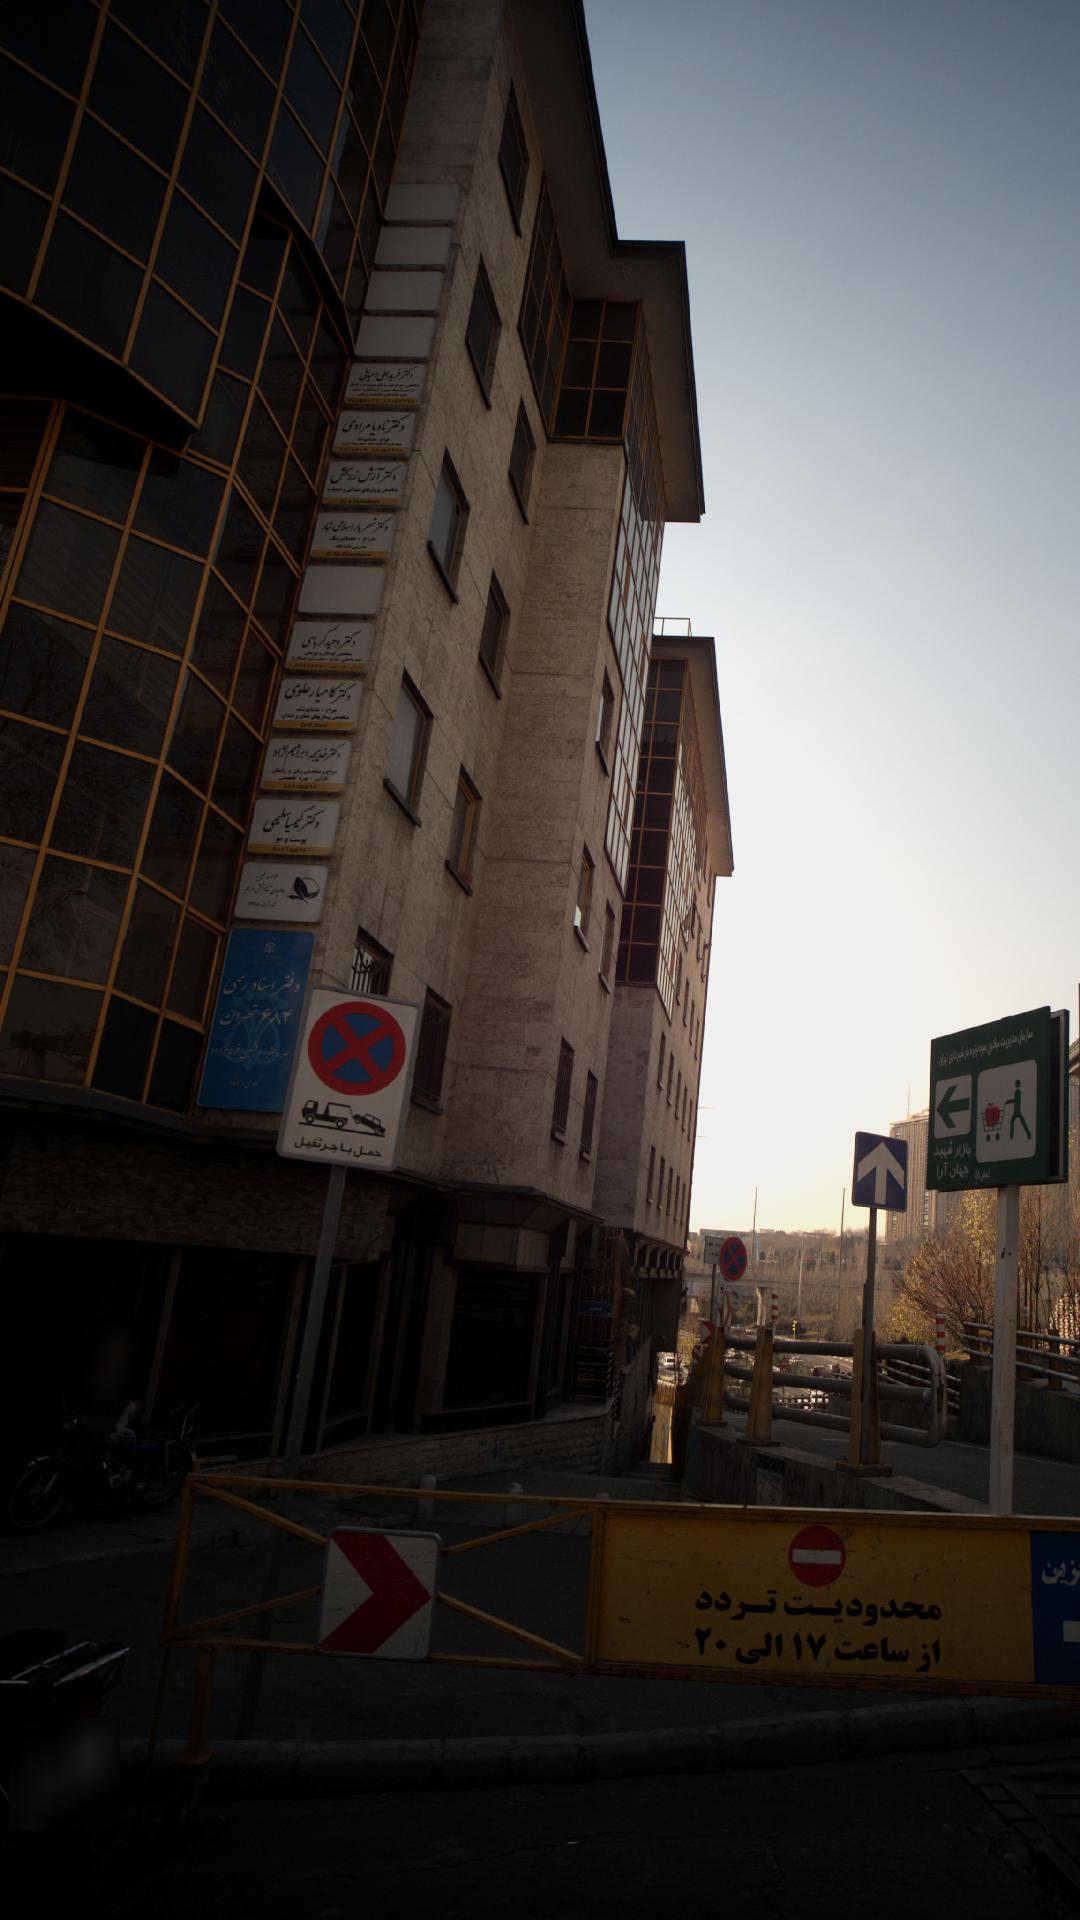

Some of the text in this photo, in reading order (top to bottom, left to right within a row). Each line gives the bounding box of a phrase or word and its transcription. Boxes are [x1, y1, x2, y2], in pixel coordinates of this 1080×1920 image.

[398, 366, 418, 381] دکتر
[343, 419, 371, 433] مرادی
[385, 414, 410, 433] دکتر
[358, 466, 385, 483] آرش
[377, 464, 402, 484] دکتر
[370, 516, 393, 534] دکتر
[336, 629, 362, 650] دکتر
[284, 682, 359, 705] دکتر کامیار علوی
[320, 742, 346, 761] دکتر
[263, 804, 328, 833] دکتر کیمیا سلیمی
[223, 971, 301, 996] دفتر اسناد رسمی
[218, 1003, 259, 1025] تهران
[293, 1136, 383, 1157] حمل با جرثقیل
[932, 1139, 972, 1160] بازار شهید
[936, 1161, 949, 1181] آرا
[949, 1162, 969, 1179] جهان
[695, 1589, 941, 1627] محدودیت تردد
[694, 1627, 940, 1672] از ساعت ۱۷ الی ۲۰
